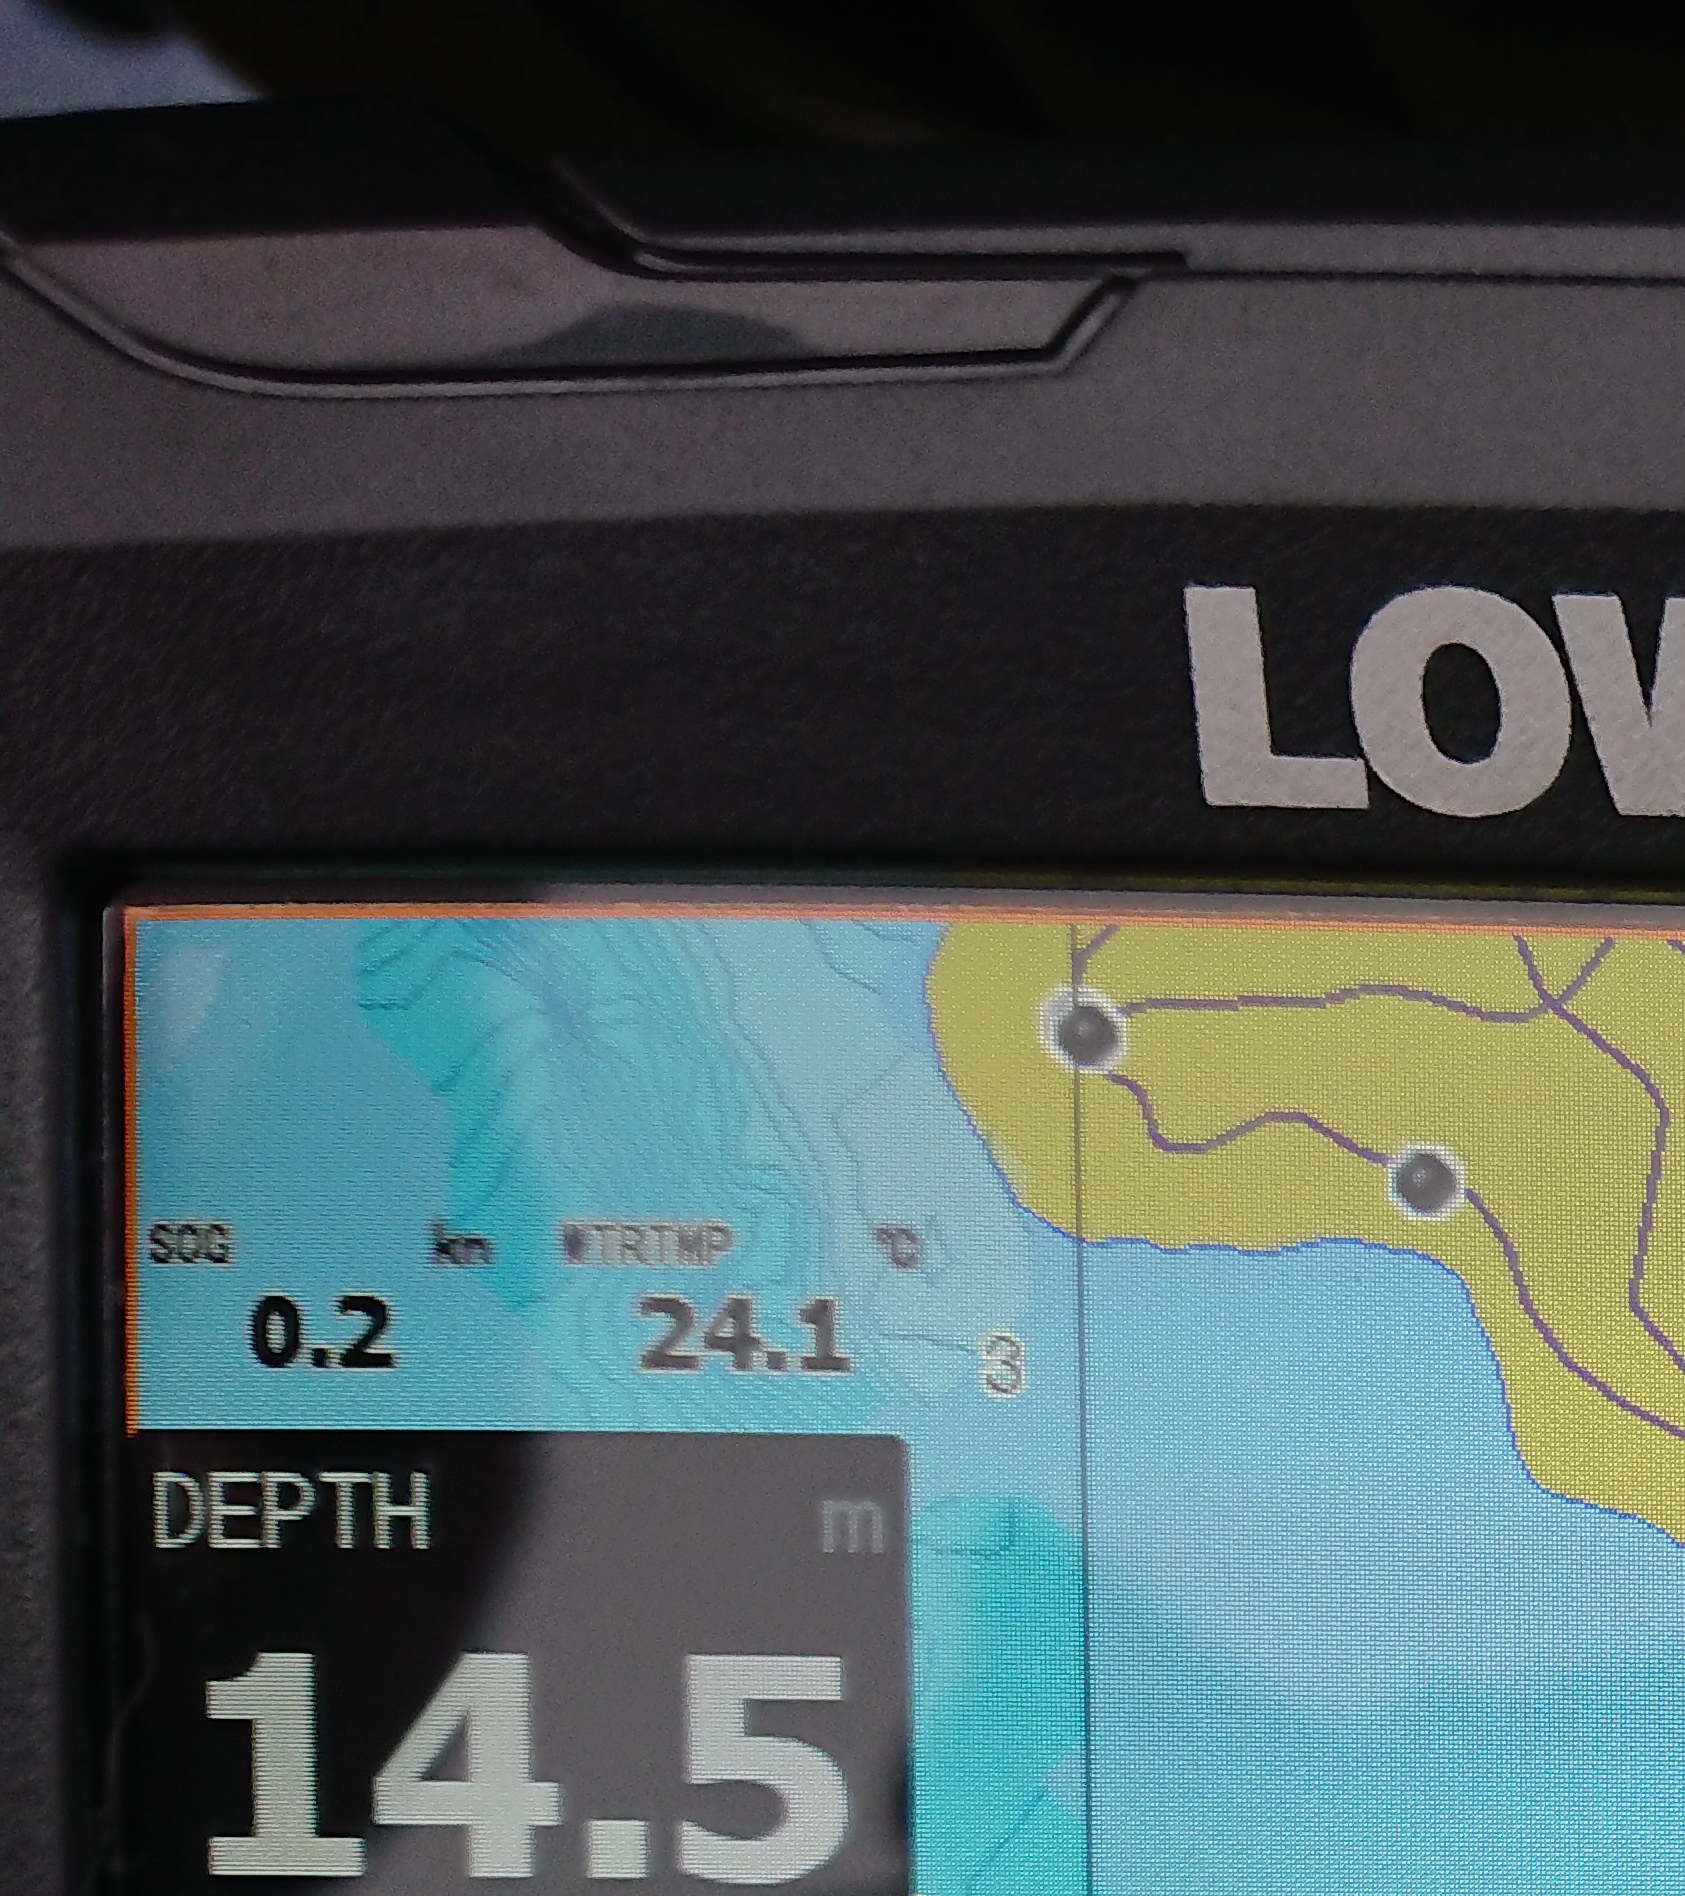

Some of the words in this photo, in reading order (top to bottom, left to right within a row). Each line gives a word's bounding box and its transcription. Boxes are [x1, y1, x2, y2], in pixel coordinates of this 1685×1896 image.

[147, 1221, 232, 1266] SOG
[432, 1220, 491, 1266] kn
[562, 1221, 736, 1267] WTRTMP
[249, 1293, 398, 1370] 0.2
[637, 1296, 853, 1373] 24.1
[980, 1332, 1026, 1399] 3
[150, 1470, 433, 1550] DEPTH
[821, 1497, 884, 1554] m
[204, 1650, 851, 1887] 14.5
